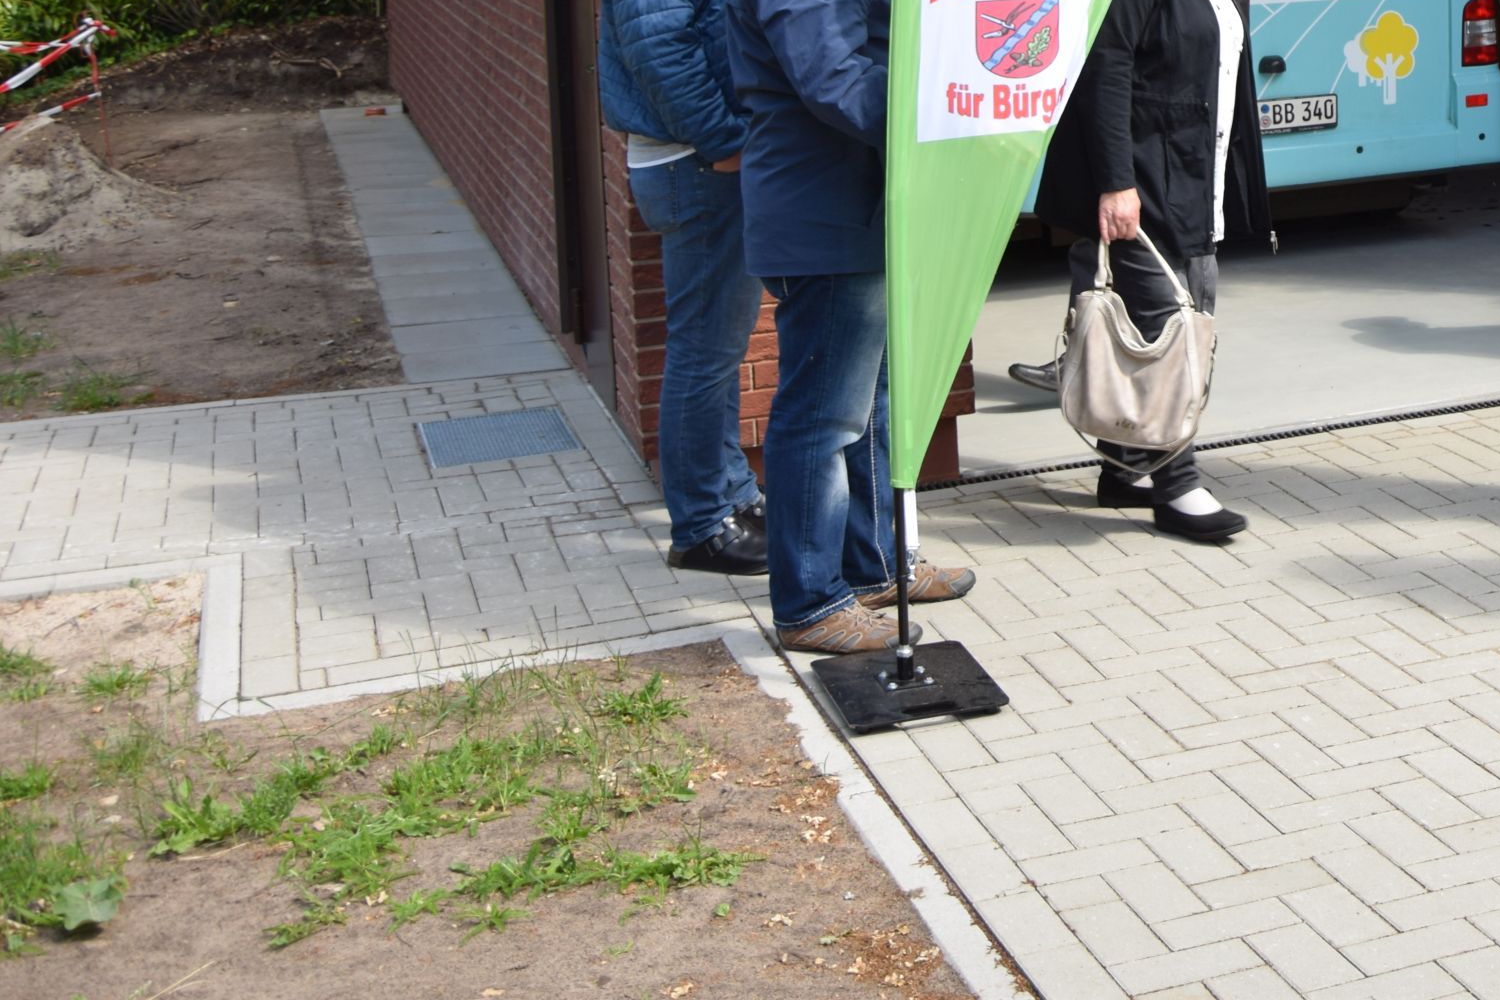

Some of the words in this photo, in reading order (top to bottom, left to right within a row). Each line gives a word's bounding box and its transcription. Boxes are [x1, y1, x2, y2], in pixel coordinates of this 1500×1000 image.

[946, 81, 985, 119] für
[992, 83, 1065, 124] Bürg
[1272, 102, 1295, 125] BB
[1301, 98, 1334, 122] 340
